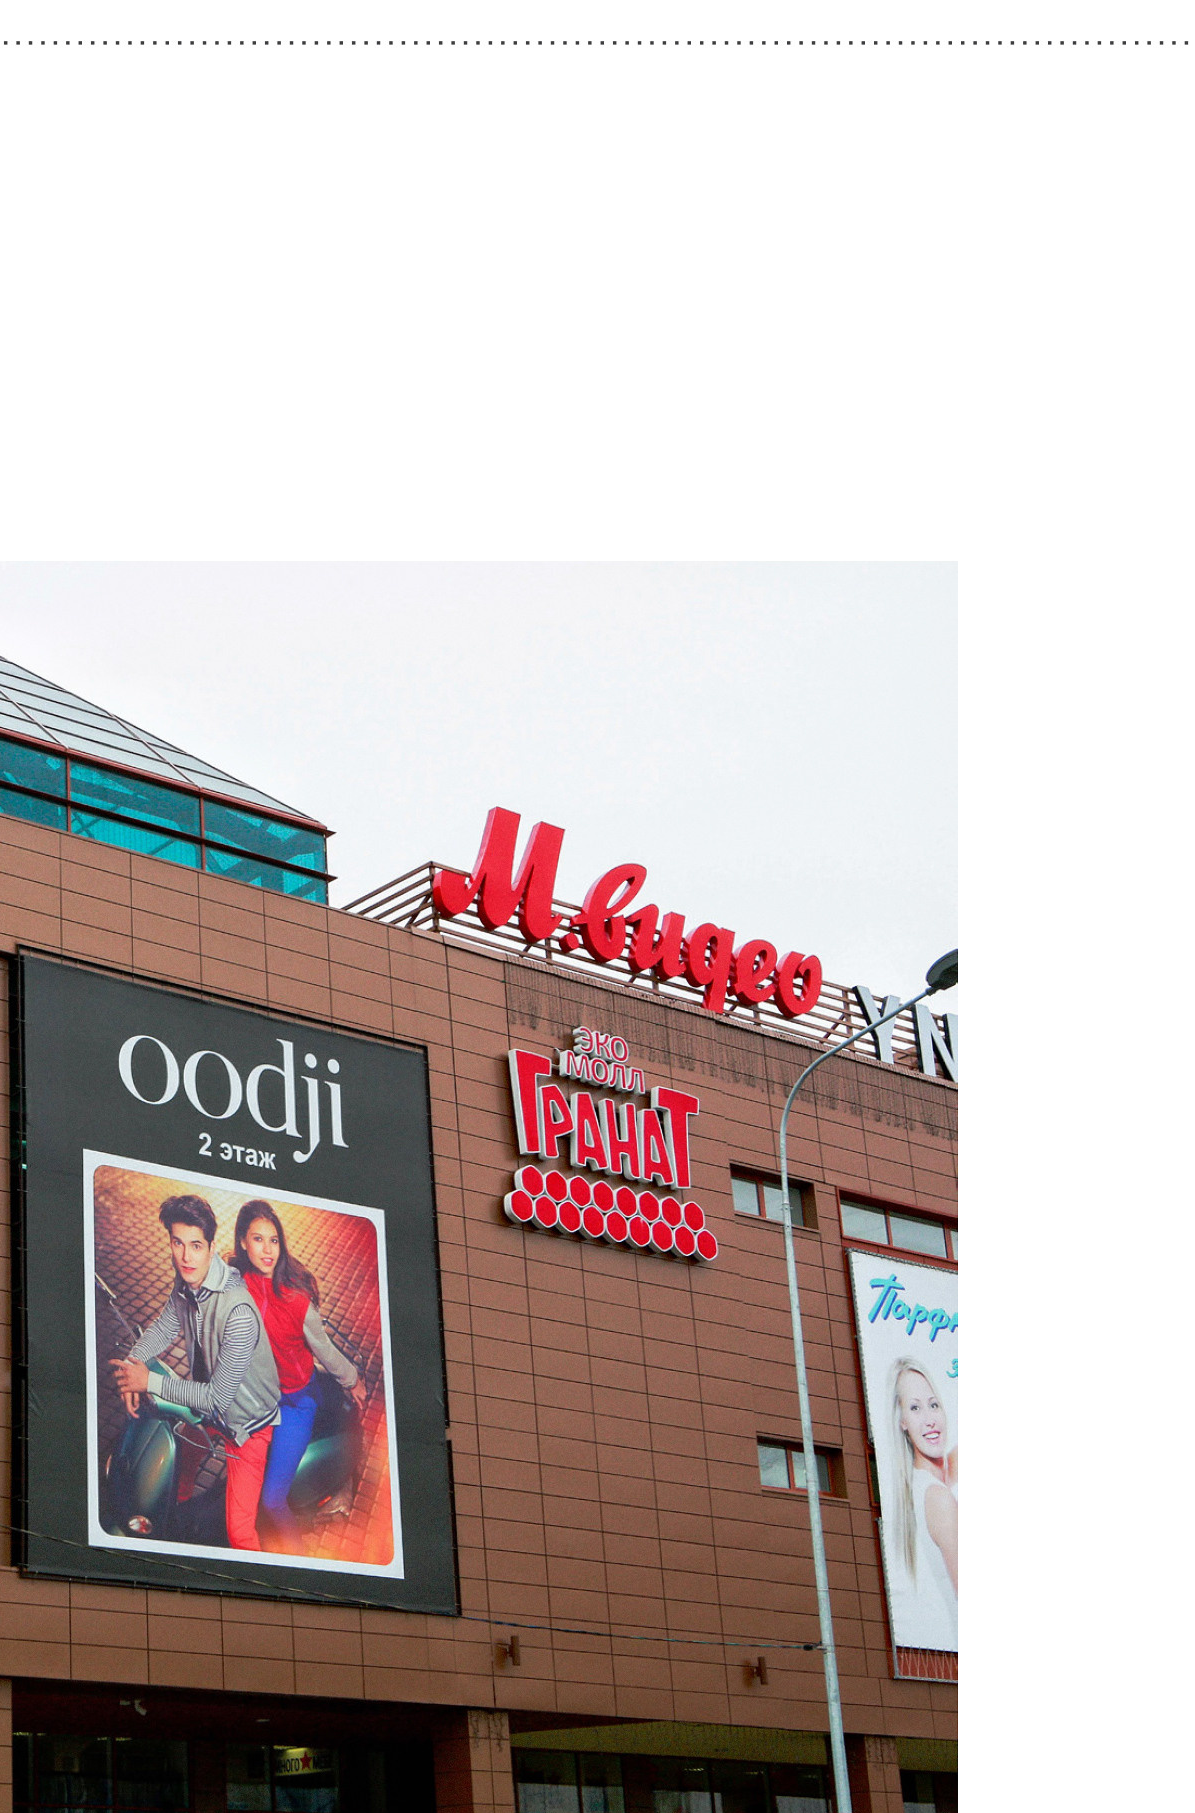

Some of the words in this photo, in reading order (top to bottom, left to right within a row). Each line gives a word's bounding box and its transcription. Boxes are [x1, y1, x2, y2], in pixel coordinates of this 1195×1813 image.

[433, 806, 822, 1018] М.видео
[559, 1049, 646, 1095] МОЛЛ
[573, 1026, 629, 1062] ЭКО
[118, 1034, 349, 1163] oodji
[508, 1048, 699, 1189] ГРАНАТ
[197, 1131, 213, 1158] 2
[219, 1142, 277, 1171] этаж
